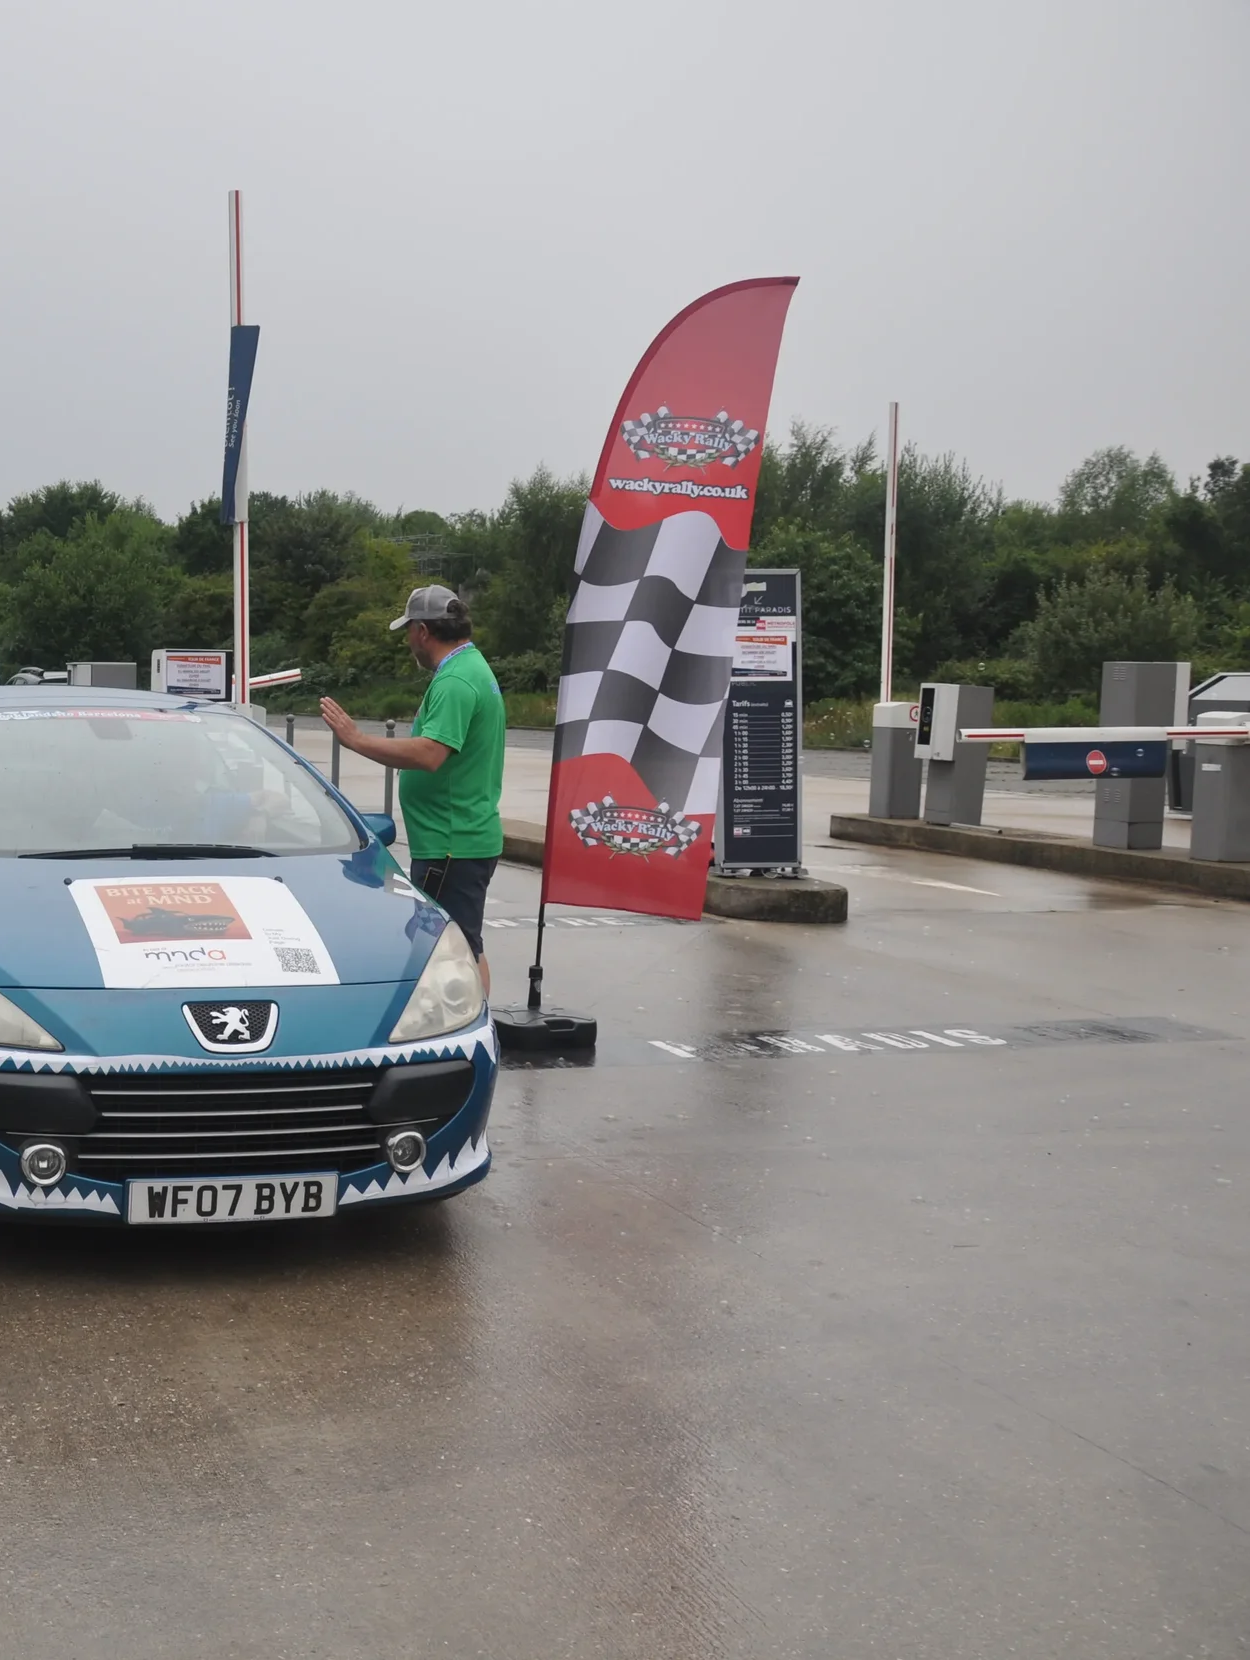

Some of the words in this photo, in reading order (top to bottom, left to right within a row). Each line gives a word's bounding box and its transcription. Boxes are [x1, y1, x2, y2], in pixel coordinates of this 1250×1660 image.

[228, 434, 236, 448] See
[233, 399, 241, 417] soon
[644, 431, 691, 446] Wacky
[694, 434, 733, 452] Rally
[608, 478, 749, 499] wackyrally.co.uk
[590, 819, 635, 833] Wacky
[637, 822, 676, 841] Rally
[106, 886, 156, 897] BITE
[159, 886, 216, 895] BACK
[146, 895, 212, 905] MND
[145, 947, 227, 962] mnda
[647, 1029, 1008, 1058] PRADIS
[147, 1184, 243, 1218] WF07
[254, 1180, 323, 1215] BYB
